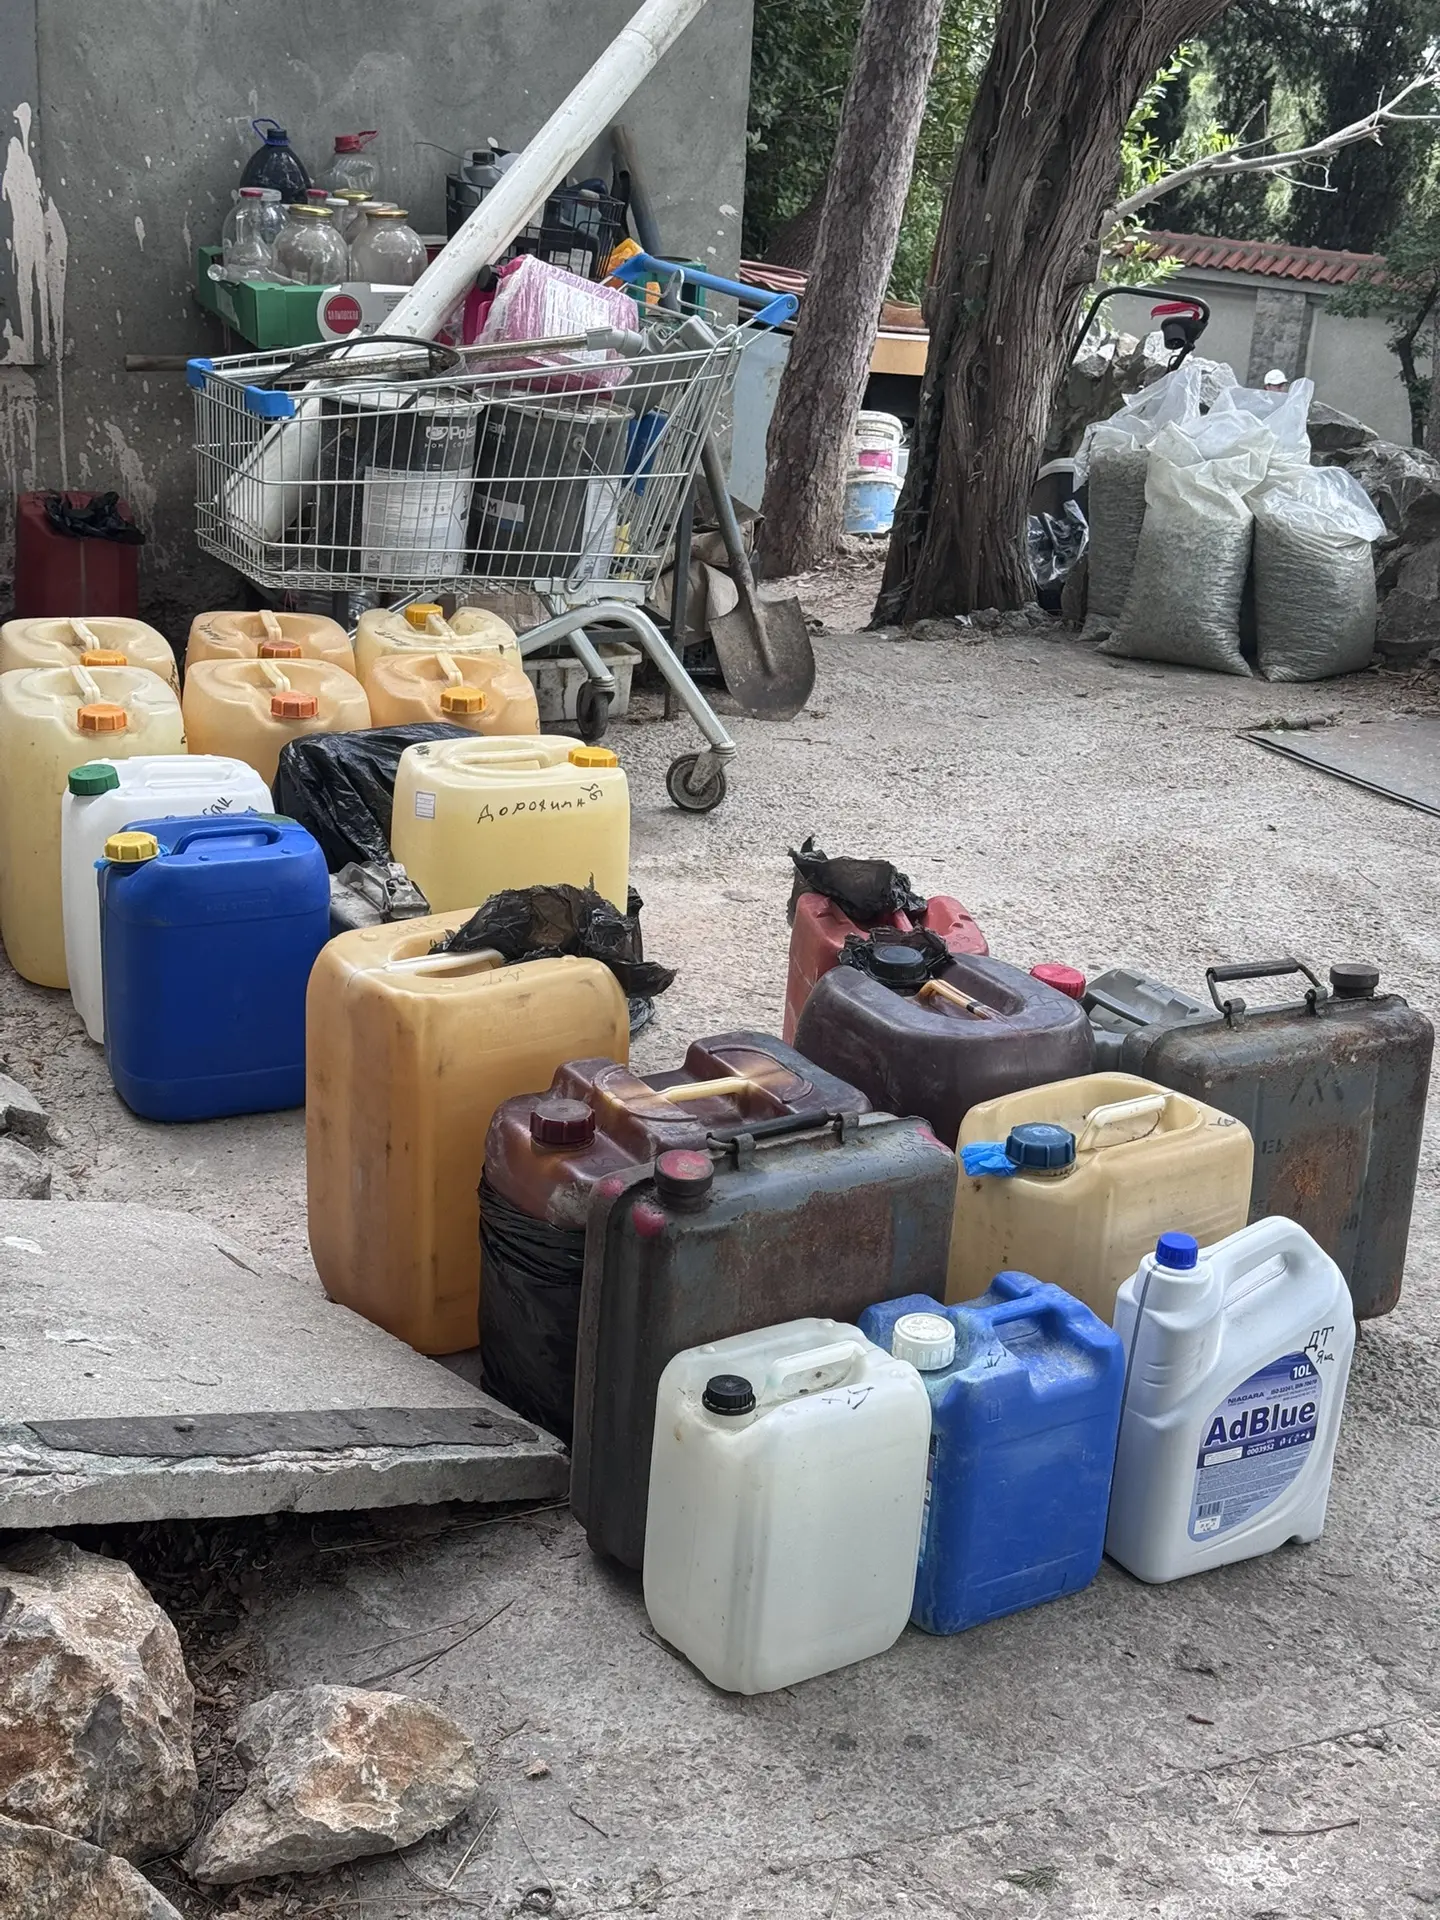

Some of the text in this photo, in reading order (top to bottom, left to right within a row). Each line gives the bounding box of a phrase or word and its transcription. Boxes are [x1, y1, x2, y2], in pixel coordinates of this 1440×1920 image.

[1303, 1326, 1334, 1354] ДТ
[1292, 1364, 1312, 1379] 10L
[1227, 1391, 1265, 1405] NIAGARA
[1203, 1401, 1316, 1447] AdBlue
